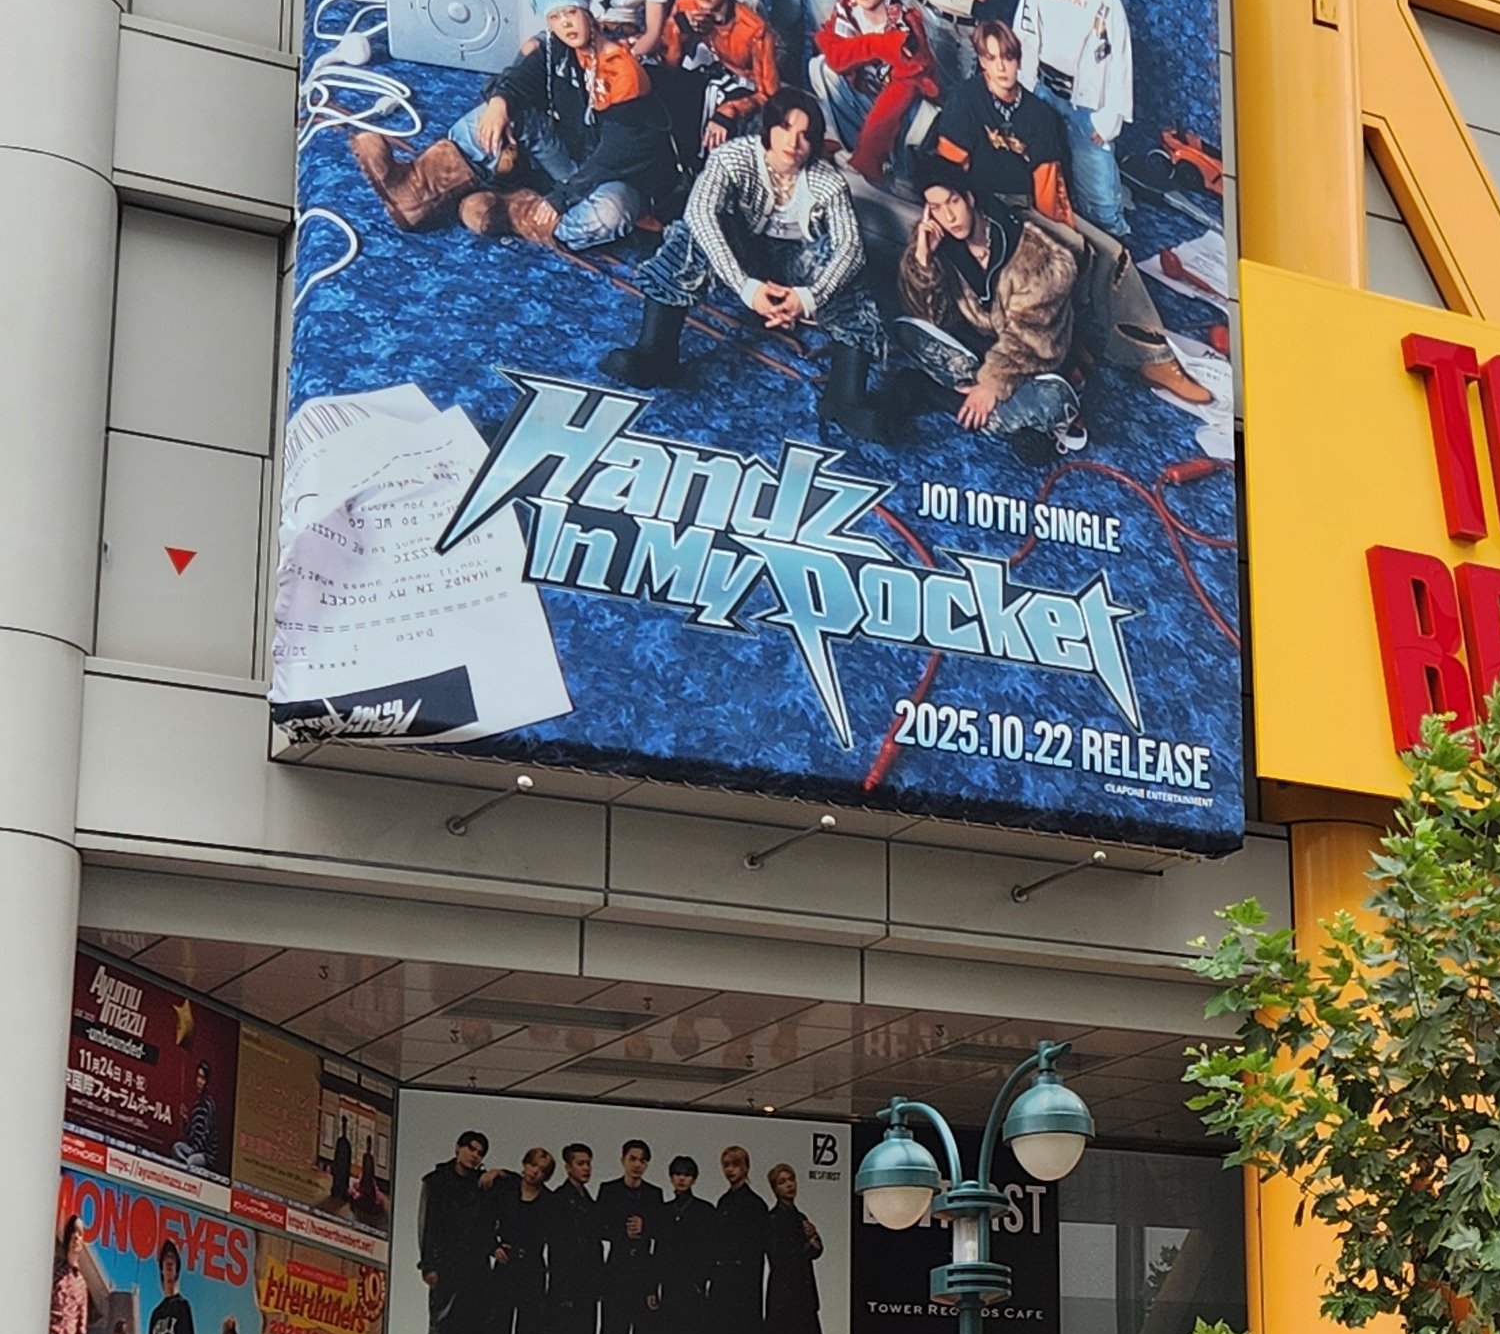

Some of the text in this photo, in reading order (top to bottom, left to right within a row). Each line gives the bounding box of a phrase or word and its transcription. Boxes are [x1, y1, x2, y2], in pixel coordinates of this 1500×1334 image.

[433, 368, 900, 561] Handz
[919, 482, 1121, 554] JO1 10TH SINGLE
[319, 567, 489, 606] HANDZ IN MY POCKET
[526, 497, 1146, 747] In My Pocket
[894, 699, 1211, 790] 2025.10.22 RELEASE
[90, 965, 143, 1012] Ayumu
[99, 1000, 148, 1039] Imazu
[928, 1304, 1000, 1318] RECDS
